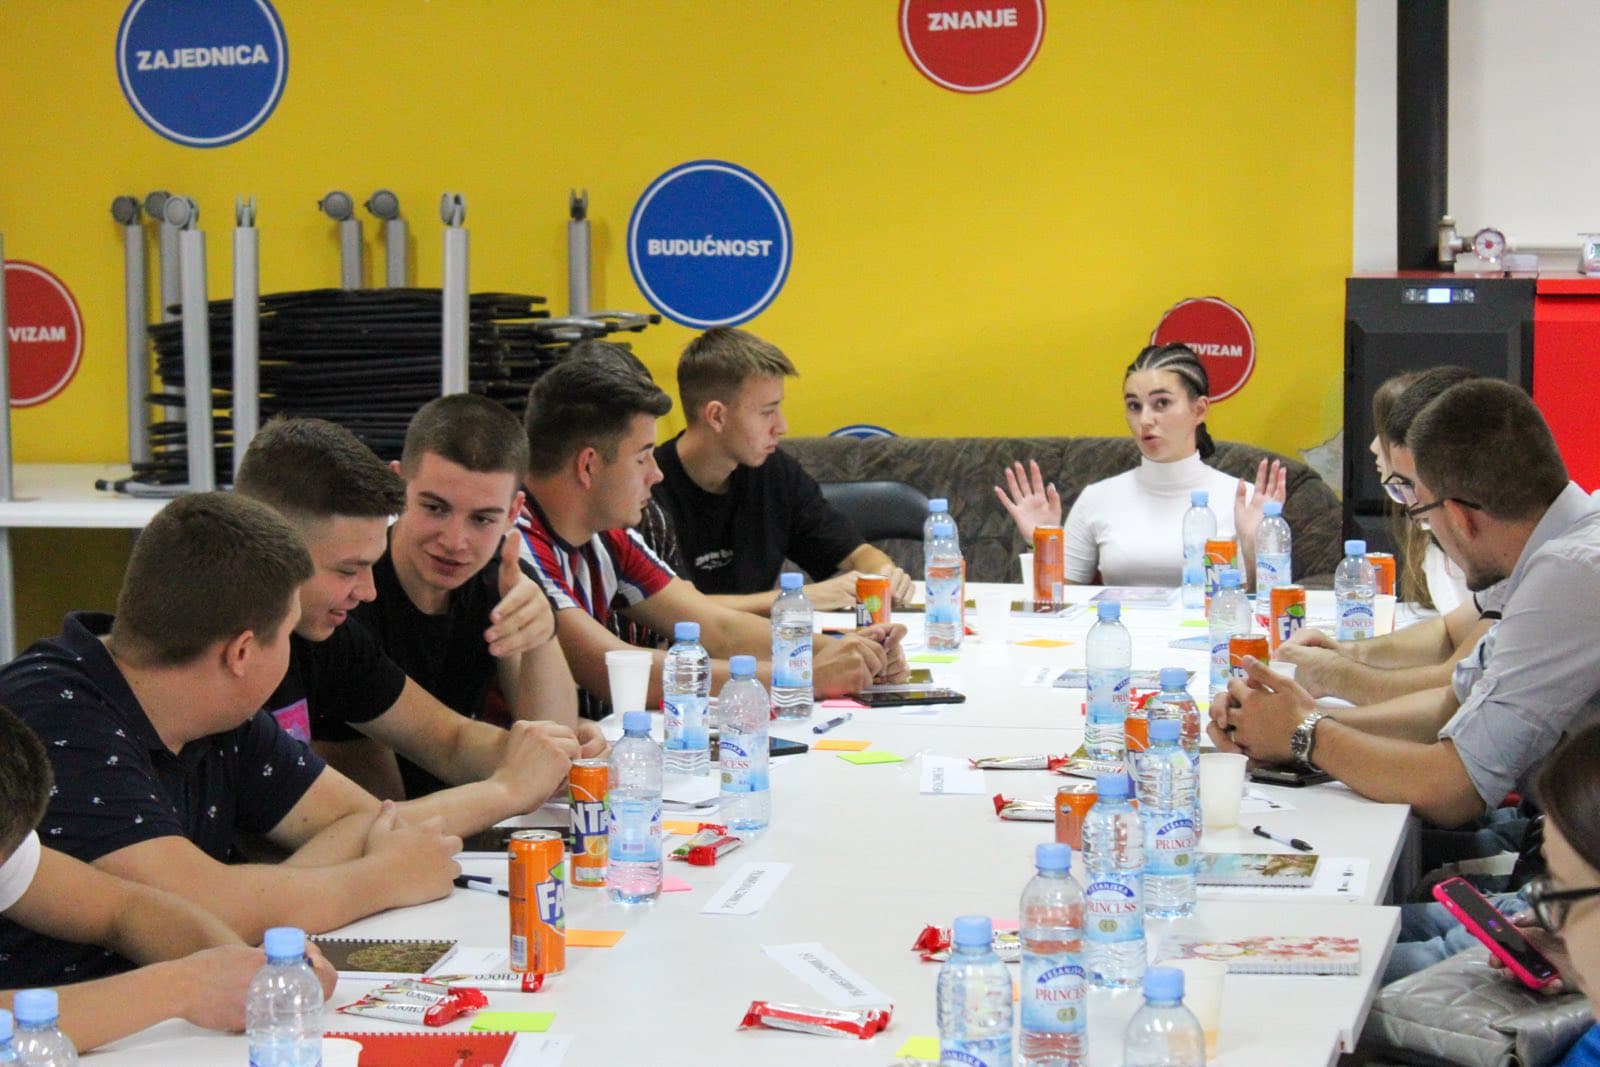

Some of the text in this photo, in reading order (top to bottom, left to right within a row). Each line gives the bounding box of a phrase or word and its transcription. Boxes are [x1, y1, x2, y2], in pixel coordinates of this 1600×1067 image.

[927, 7, 1018, 31] ZNANJE
[136, 43, 270, 71] ZAJEDNICA
[647, 234, 773, 257] BUDUĆNOST
[7, 325, 67, 342] VIZAM
